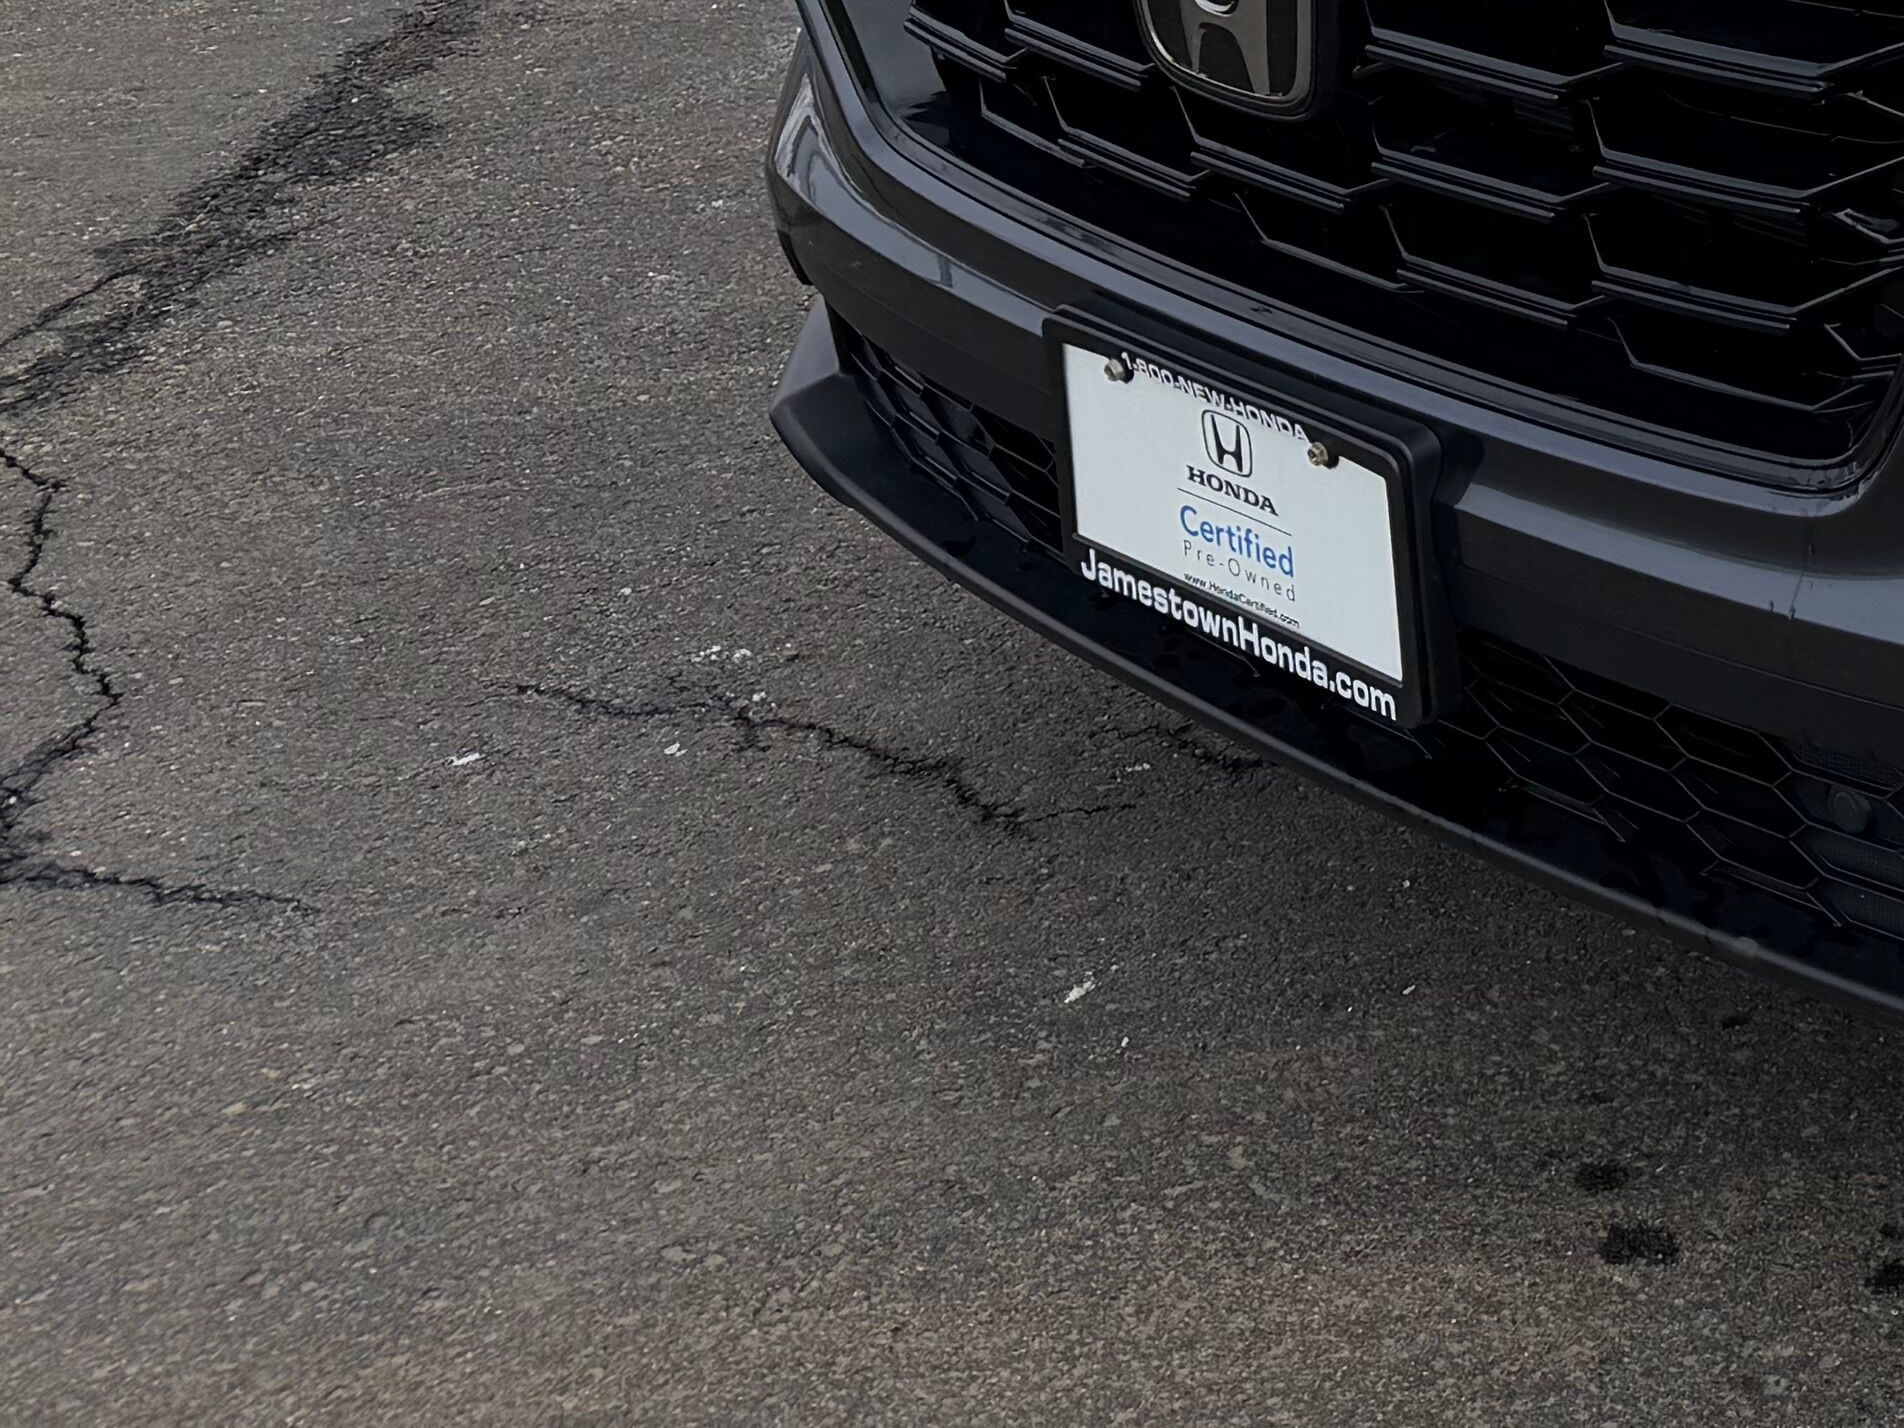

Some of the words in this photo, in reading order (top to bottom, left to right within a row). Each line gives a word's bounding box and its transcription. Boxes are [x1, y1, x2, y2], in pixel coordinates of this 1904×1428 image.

[1186, 464, 1279, 517] HONDA
[1180, 505, 1294, 578] Certified
[1183, 539, 1296, 602] Pre-Owned
[1080, 548, 1397, 722] JamestownHonda.com
